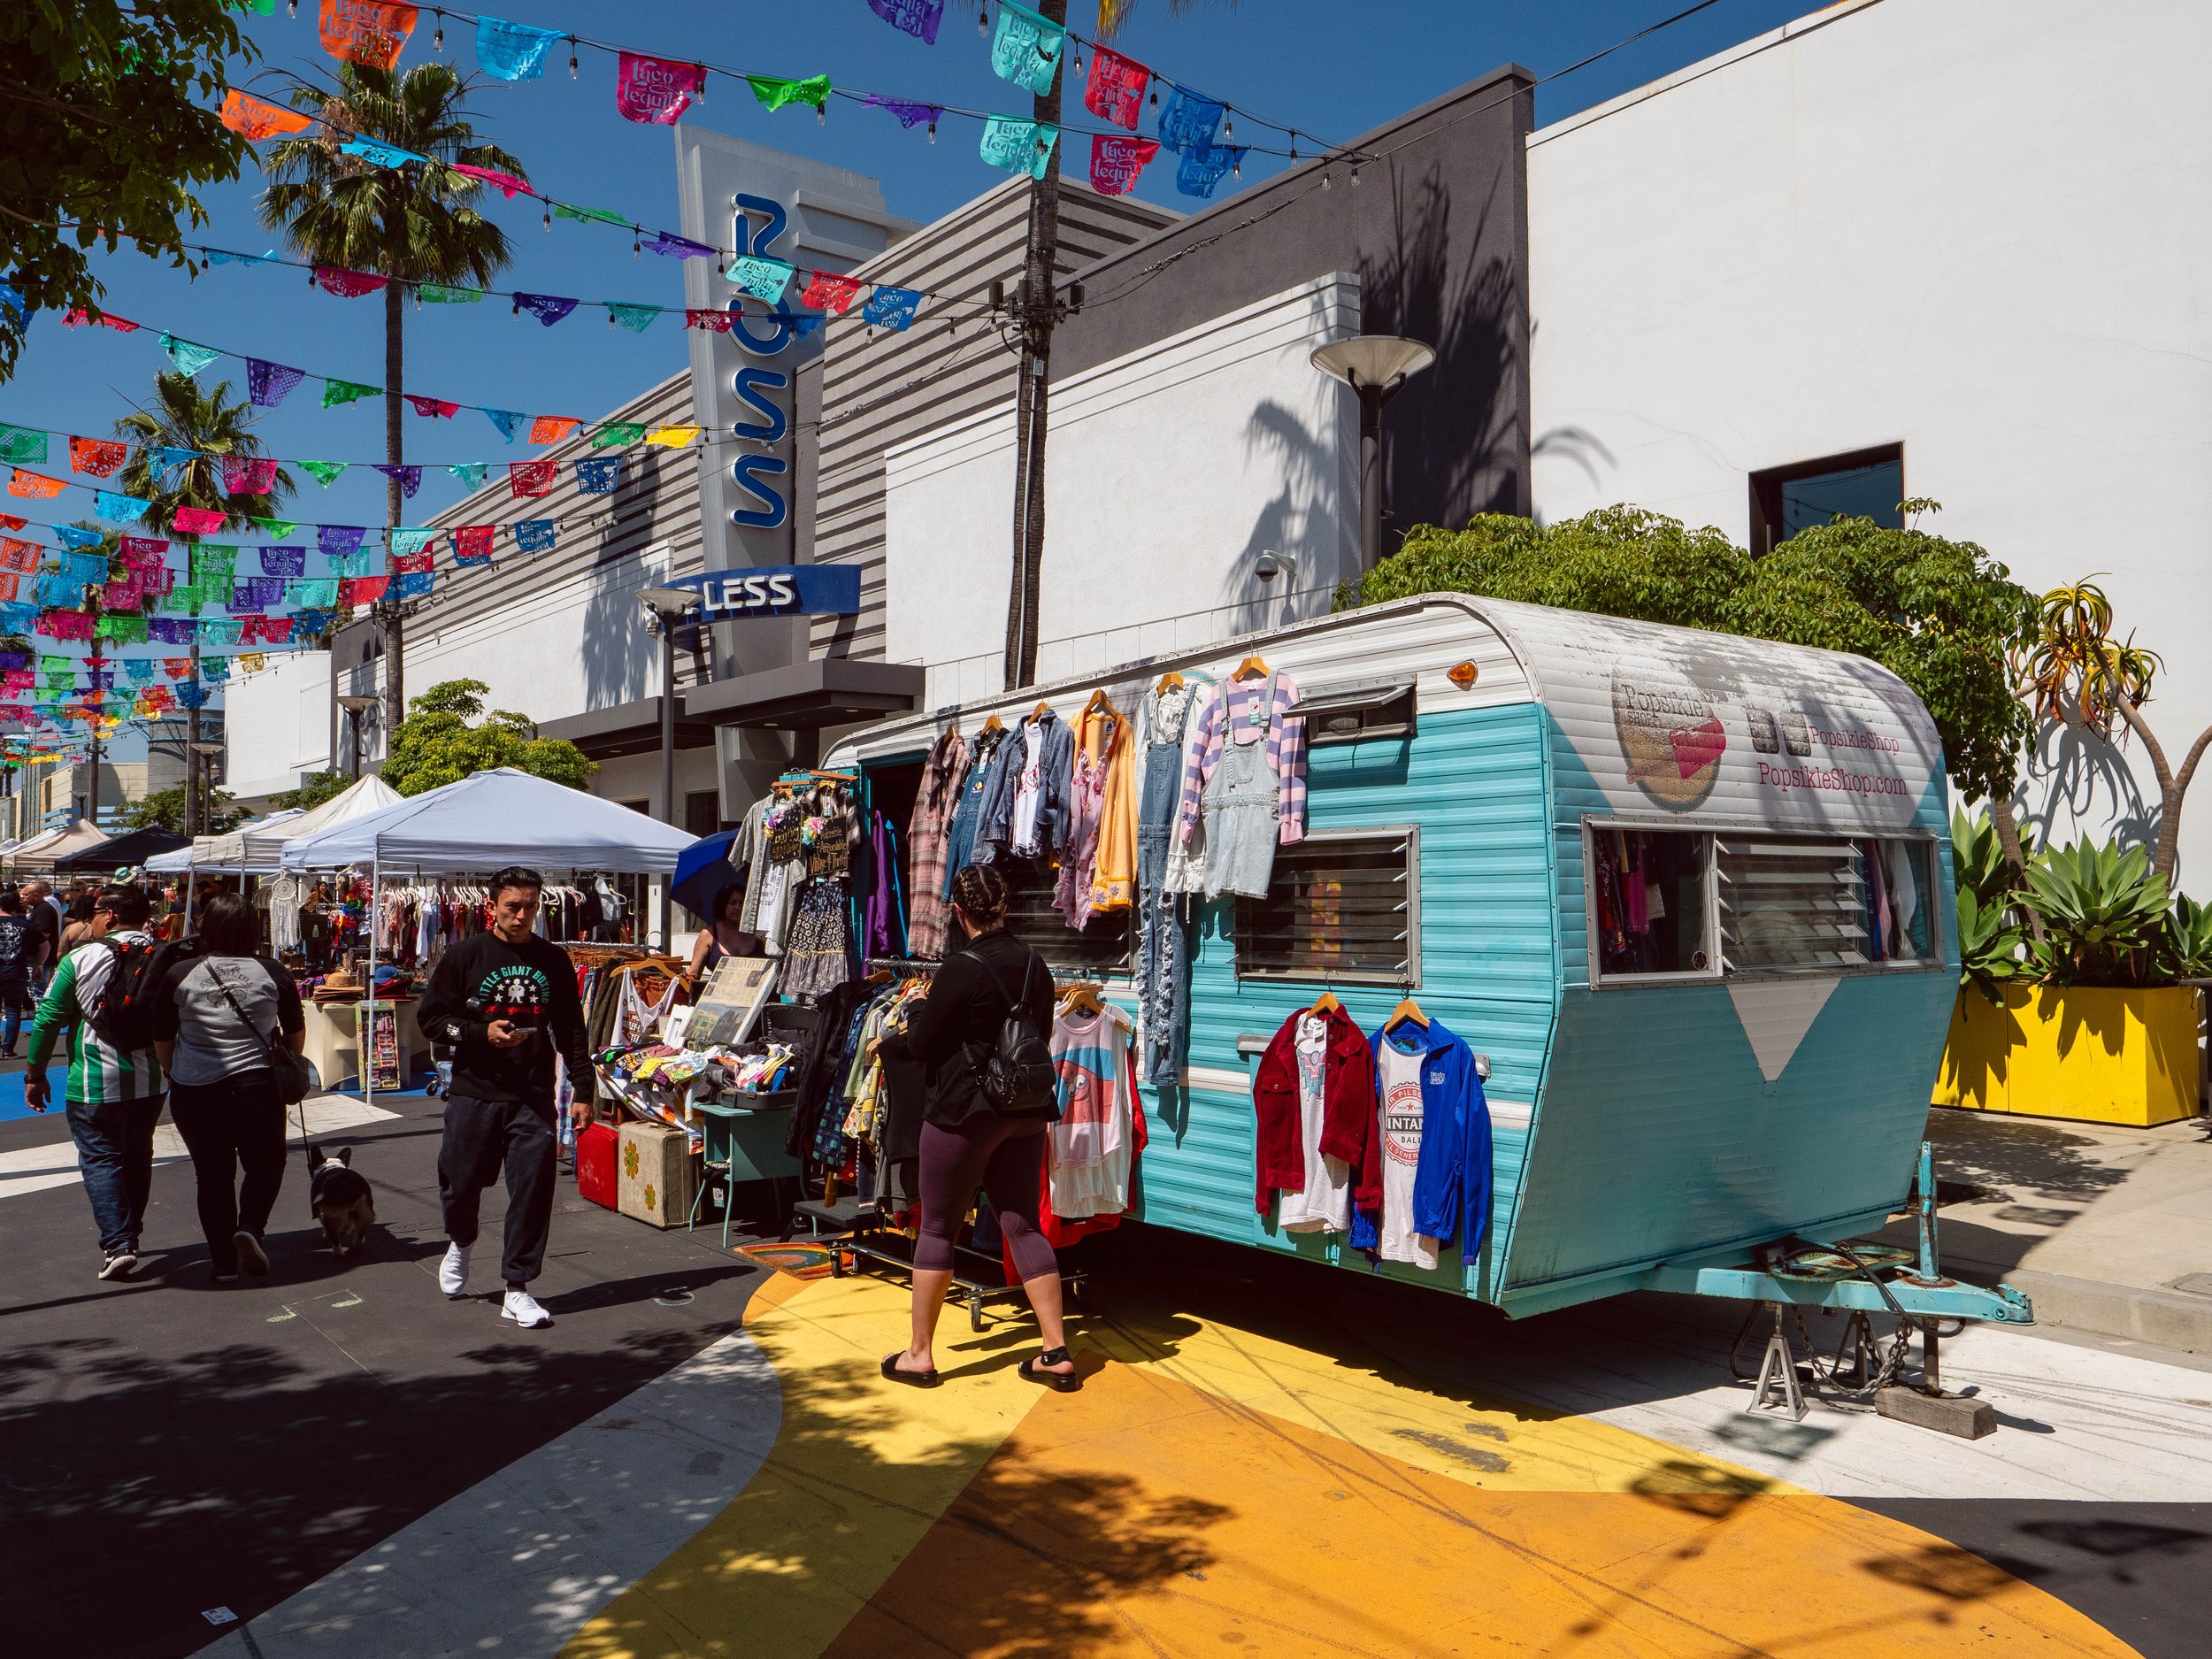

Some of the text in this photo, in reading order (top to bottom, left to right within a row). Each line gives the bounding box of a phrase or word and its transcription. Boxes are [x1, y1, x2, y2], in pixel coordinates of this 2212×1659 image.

[731, 192, 792, 529] ROSS
[703, 573, 795, 611] LESS
[1622, 684, 1703, 718] Popsikle
[1628, 711, 1653, 726] SHOP
[1809, 726, 1900, 756] PopsikleShop
[1757, 762, 1909, 798] PopsikleShop.com
[479, 965, 550, 1003] LITTLE GIANT BOXING
[1398, 1088, 1422, 1098] PILSE
[1387, 1117, 1424, 1130] INTA
